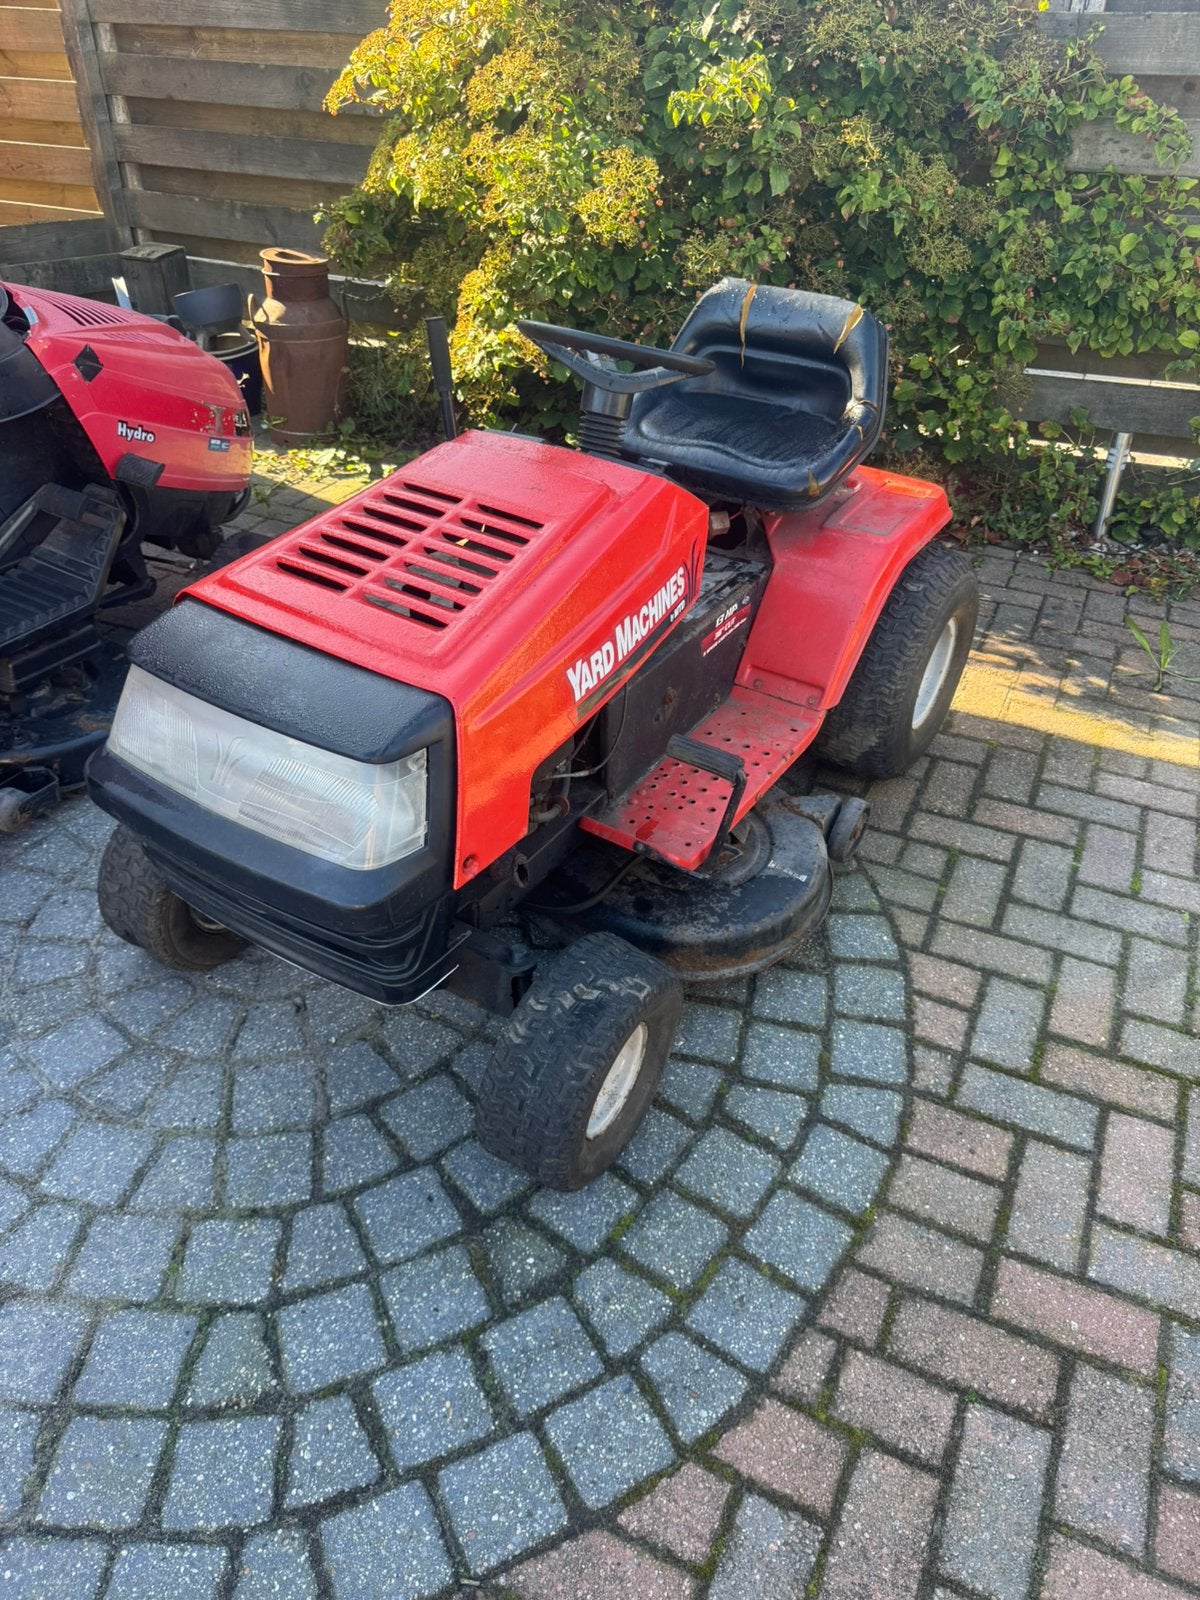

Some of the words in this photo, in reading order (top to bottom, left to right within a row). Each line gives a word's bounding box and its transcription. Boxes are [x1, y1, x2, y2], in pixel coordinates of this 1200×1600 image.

[117, 421, 155, 442] Hydro
[566, 641, 615, 702] YARD
[614, 566, 685, 662] MACHINES
